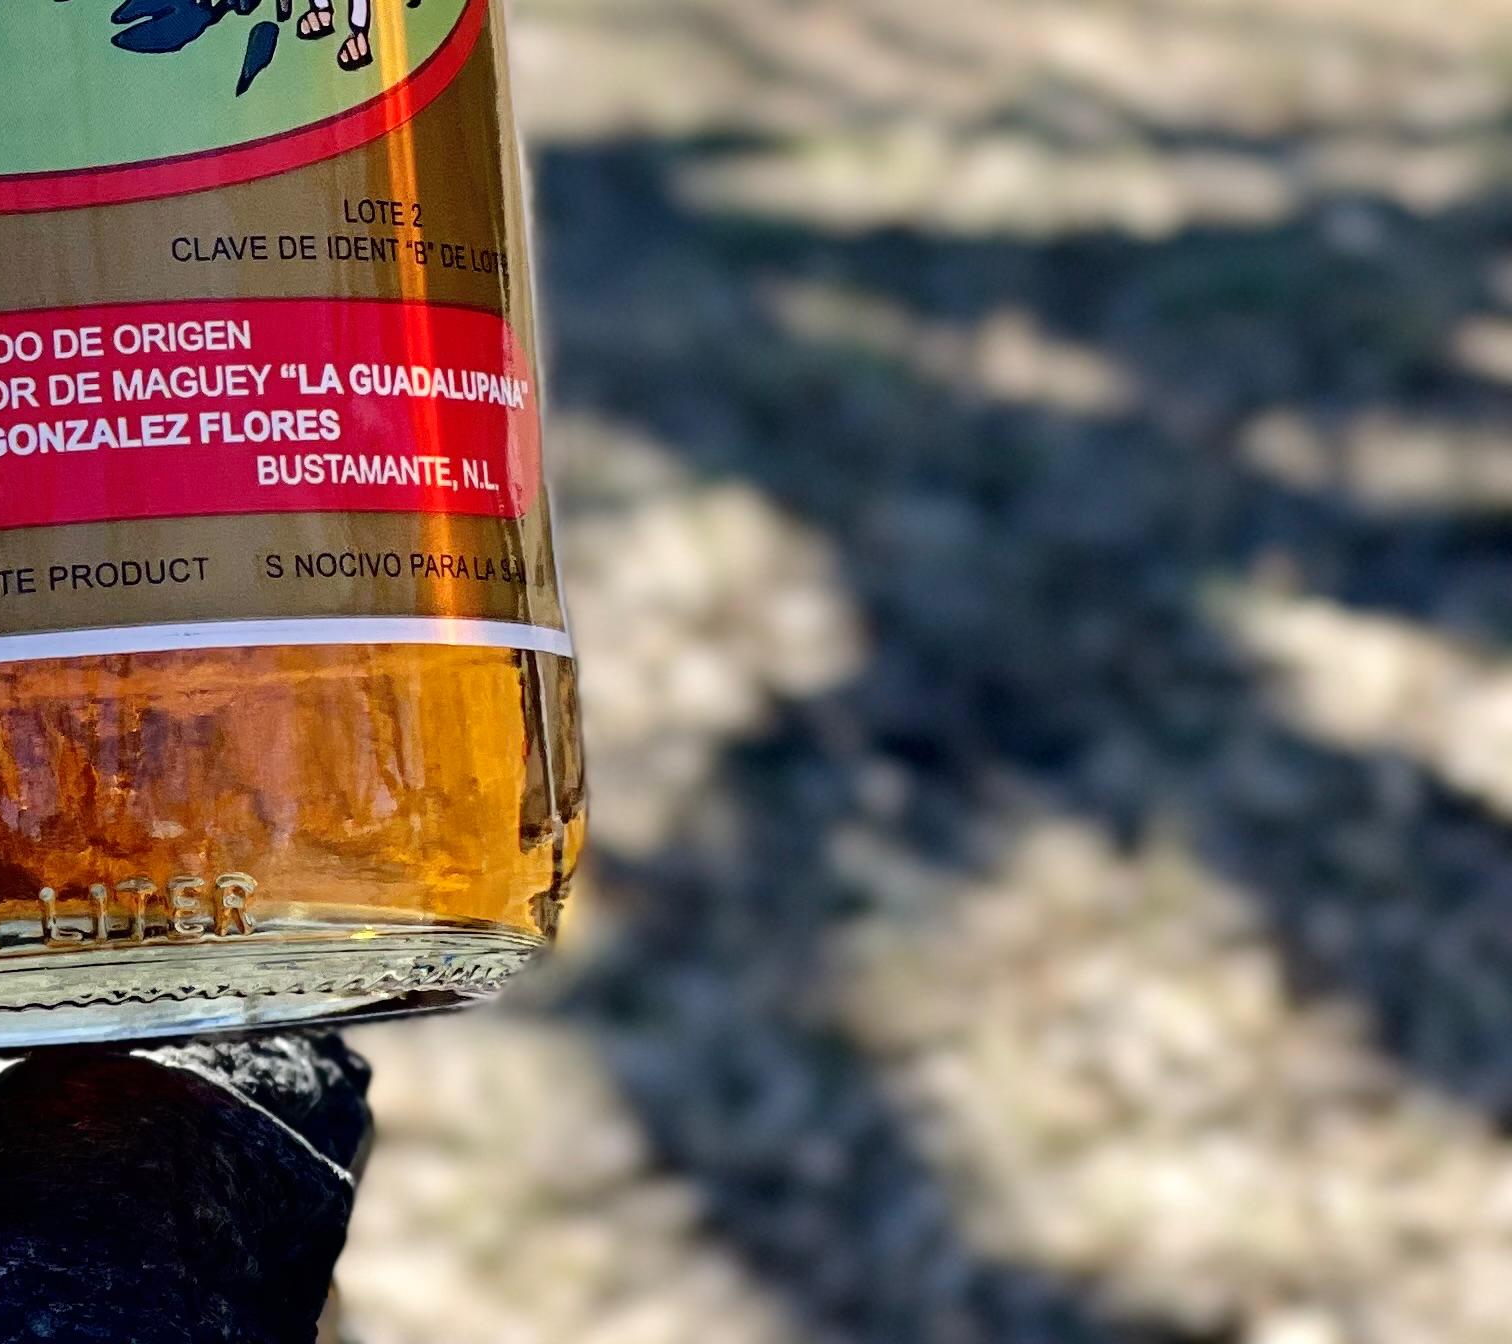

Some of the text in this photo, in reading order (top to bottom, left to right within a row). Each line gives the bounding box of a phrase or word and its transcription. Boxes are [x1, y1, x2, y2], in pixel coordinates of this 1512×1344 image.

[343, 199, 424, 228] LOTE 2
[171, 236, 268, 262] CLAVE
[278, 236, 317, 261] DE
[328, 236, 399, 263] IDENT
[441, 243, 467, 270] DE
[53, 327, 105, 359] DE
[113, 320, 251, 354] ORIGEN
[49, 372, 102, 406] DE
[113, 364, 272, 402] MAGUEY
[199, 409, 341, 444] FLORES
[257, 454, 500, 492] BUSTAMANTE, N.L.
[295, 552, 402, 579] NOCIVO
[410, 553, 469, 579] PARA
[474, 557, 495, 580] LA
[39, 872, 258, 943] LITER
